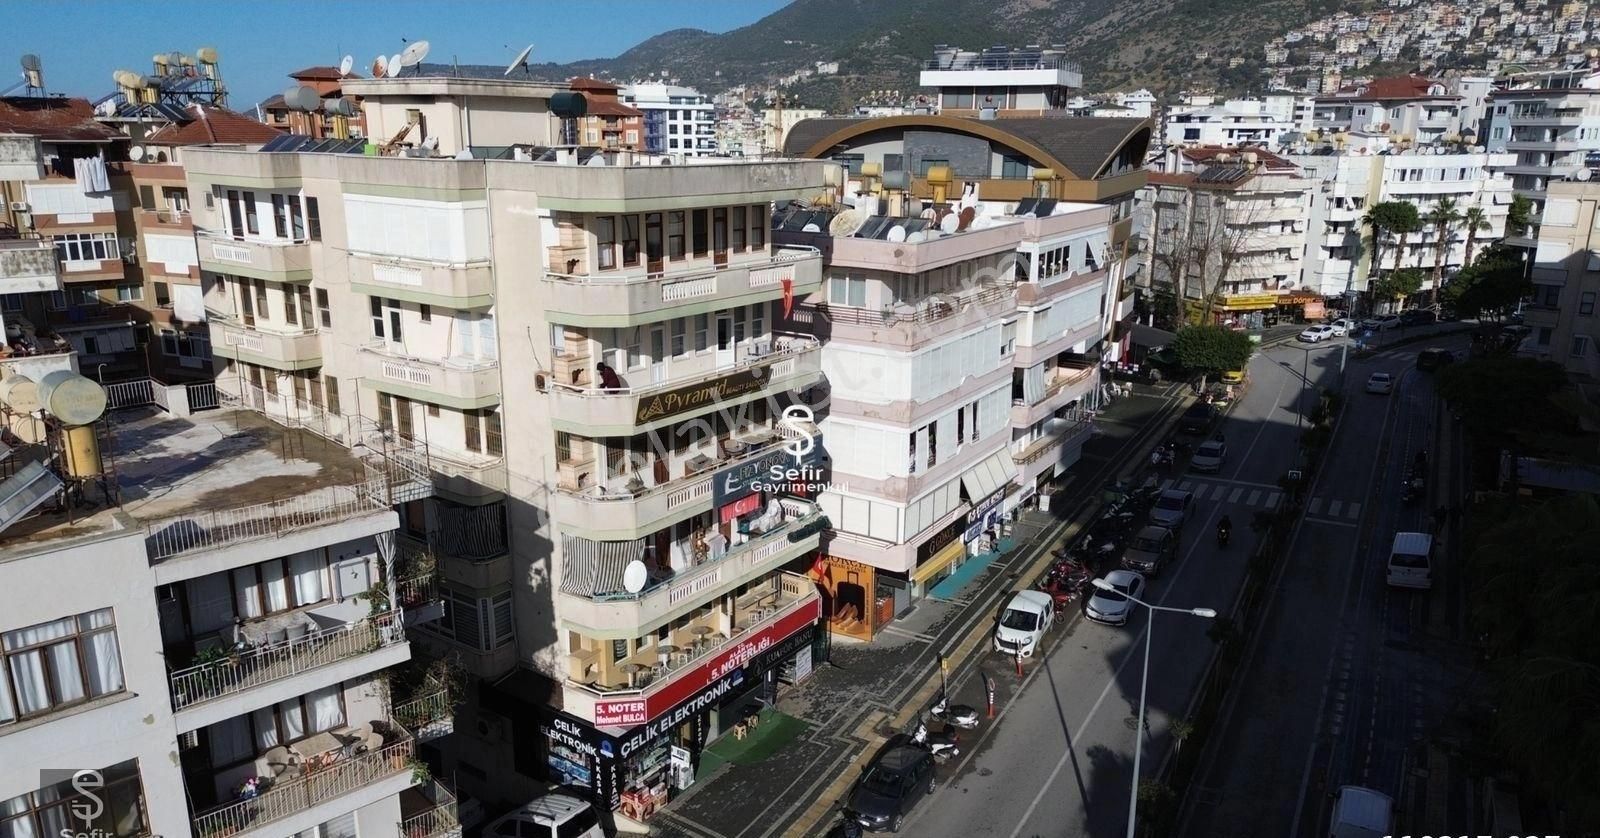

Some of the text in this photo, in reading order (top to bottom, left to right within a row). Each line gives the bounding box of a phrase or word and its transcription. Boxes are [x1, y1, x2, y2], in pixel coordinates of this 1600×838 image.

[664, 379, 728, 411] Pyramid
[711, 668, 721, 680] 5.
[597, 702, 645, 714] 5. NOTER
[554, 718, 581, 738] ÇELİK
[596, 715, 622, 725] Mehmet
[620, 725, 659, 760] ÇELİK
[660, 678, 732, 733] ELEKTRONİK
[541, 725, 597, 757] ELEKTRONİK
